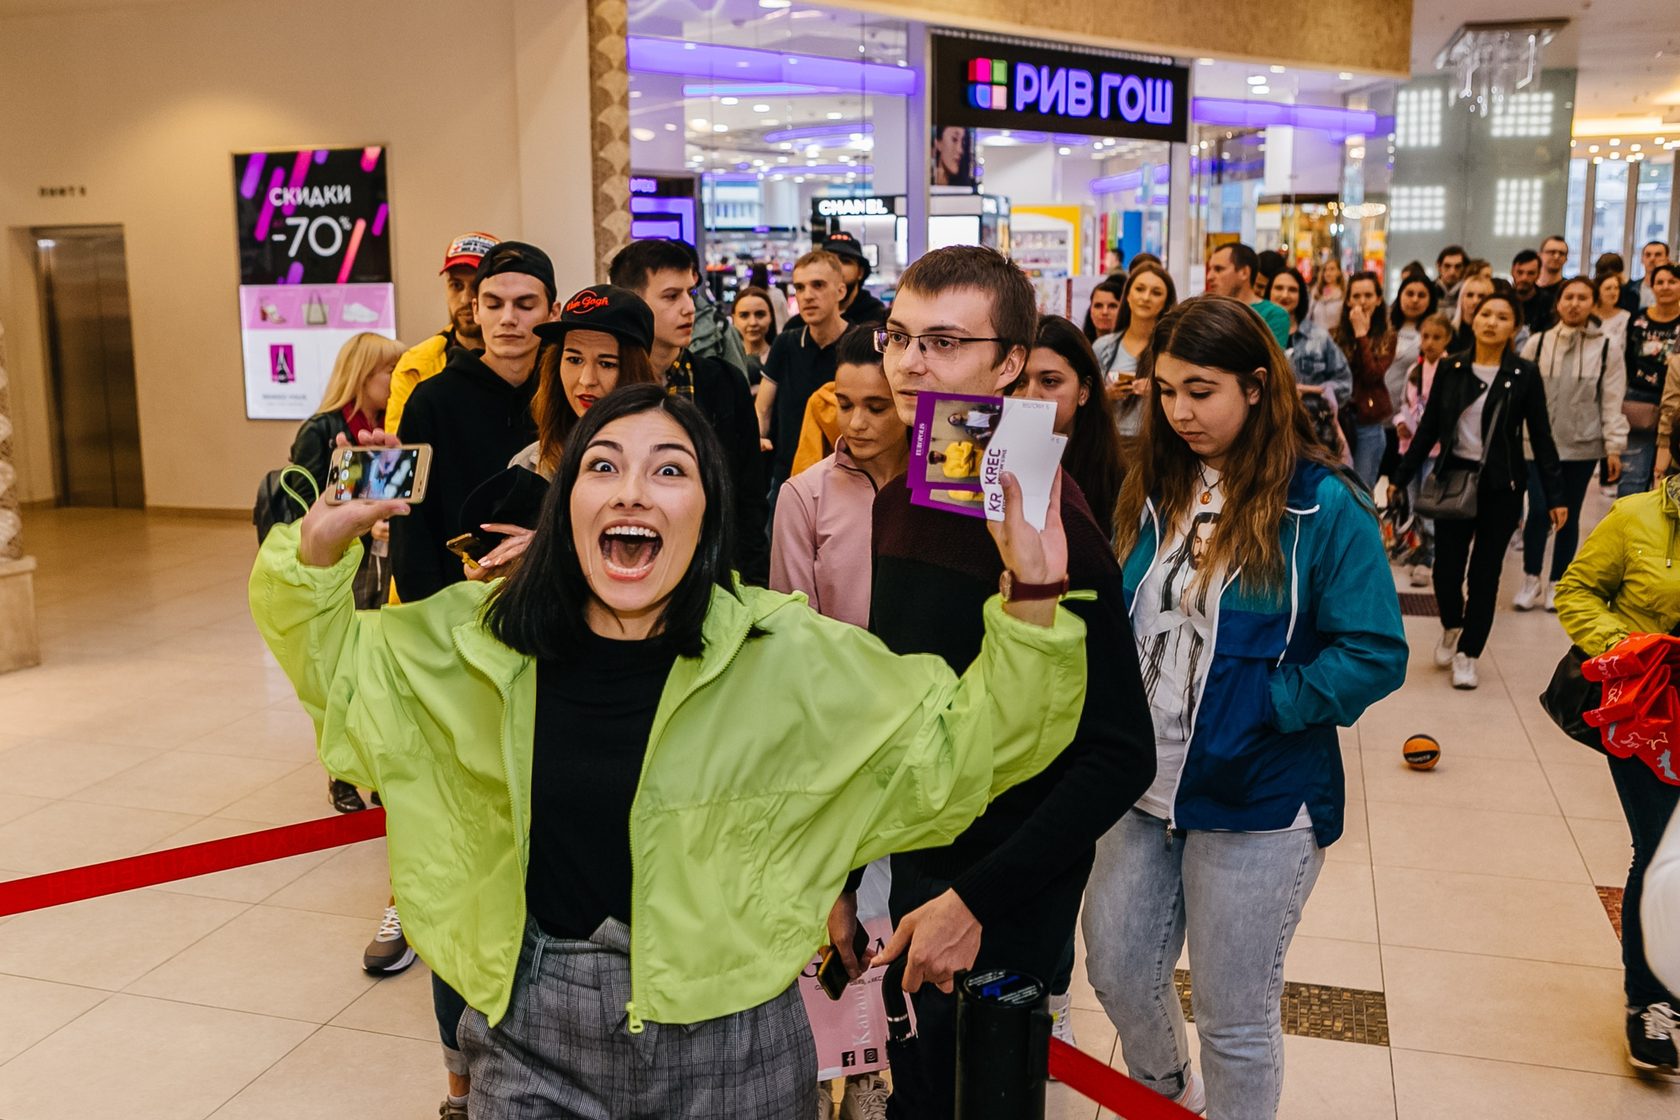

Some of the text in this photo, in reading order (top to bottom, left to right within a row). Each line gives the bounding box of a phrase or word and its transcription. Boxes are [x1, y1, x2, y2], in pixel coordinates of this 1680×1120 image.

[1014, 61, 1173, 125] РИВ ГОШ
[268, 184, 352, 208] СКИДКИ
[818, 198, 889, 216] CHANEL
[581, 296, 609, 309] Gogh
[985, 447, 1001, 485] KREC
